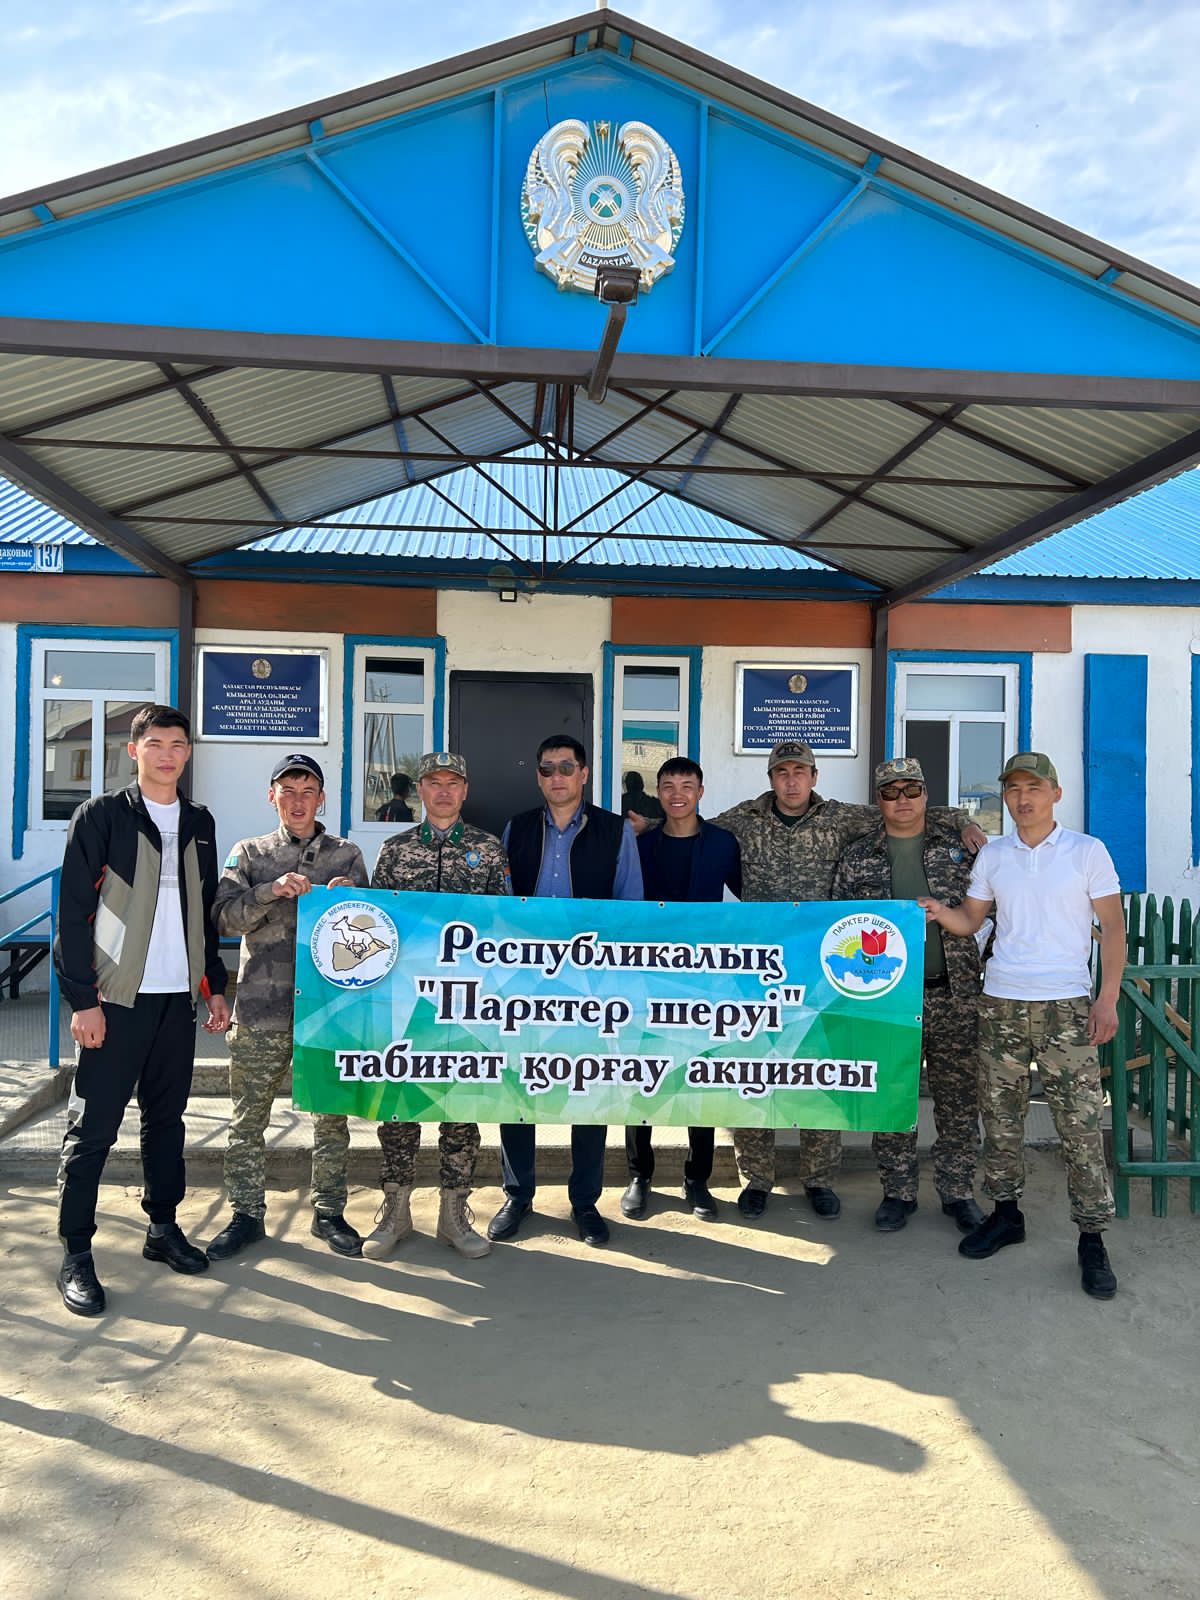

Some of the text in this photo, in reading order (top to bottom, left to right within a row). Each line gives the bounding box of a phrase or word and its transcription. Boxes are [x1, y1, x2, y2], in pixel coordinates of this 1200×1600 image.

[39, 543, 60, 567] 137
[328, 903, 376, 917] МЕМЛЕКЕТТІК
[832, 917, 896, 937] ПАРКТЕР ШЕРУІ
[441, 924, 783, 981] Республикалық
[418, 980, 801, 1038] "Парктер шеруі"
[339, 1043, 873, 1095] табиғат қорғау акциясы
